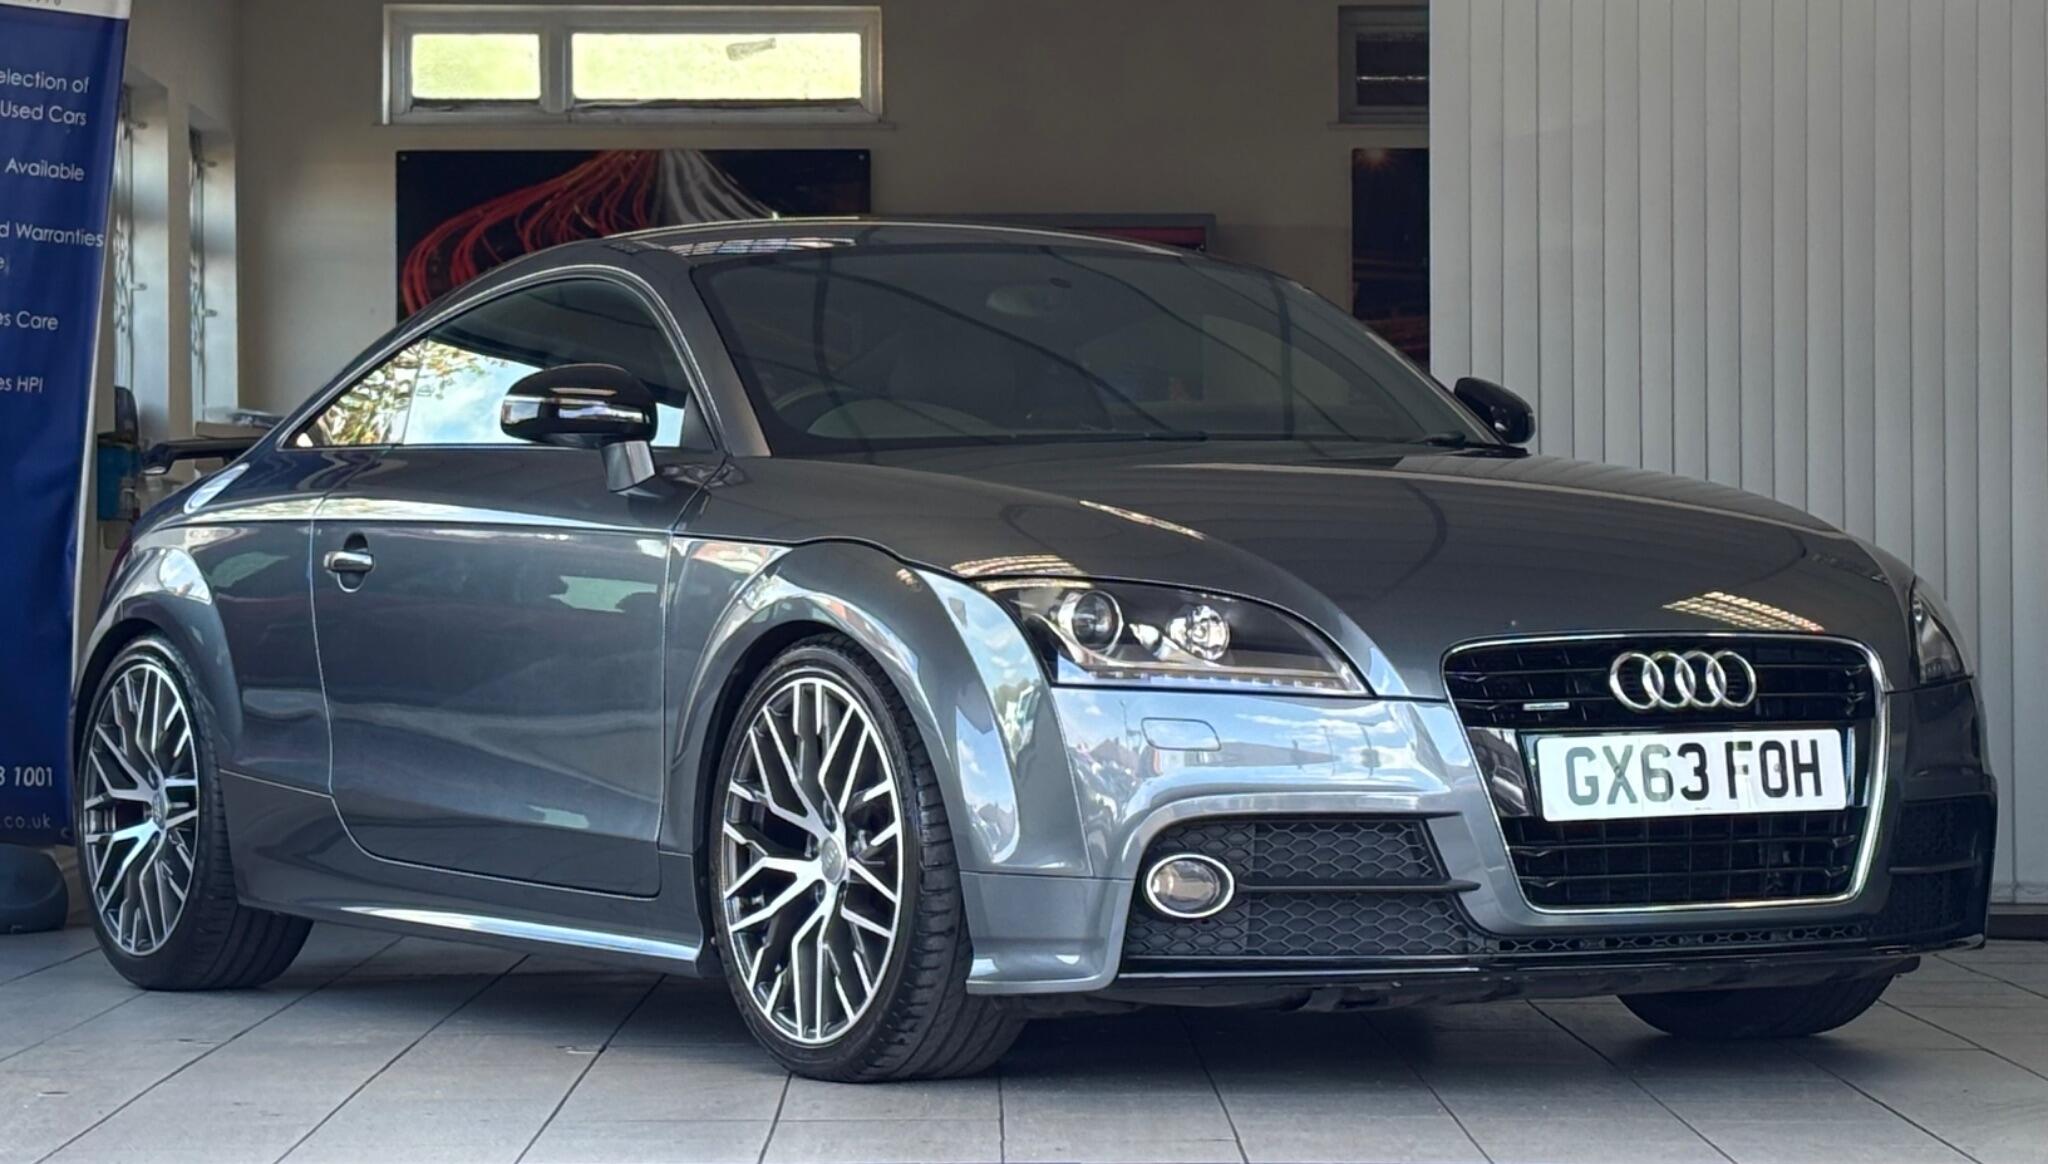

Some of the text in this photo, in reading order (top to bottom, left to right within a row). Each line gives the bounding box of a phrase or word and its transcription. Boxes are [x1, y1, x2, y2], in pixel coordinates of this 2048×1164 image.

[72, 76, 90, 93] of
[0, 100, 87, 126] Used Cars
[5, 157, 85, 181] Available
[15, 222, 104, 247] Warranties
[16, 310, 59, 331] Care
[16, 375, 44, 393] HPI
[14, 766, 53, 787] 1001
[1565, 742, 1710, 806] GX63
